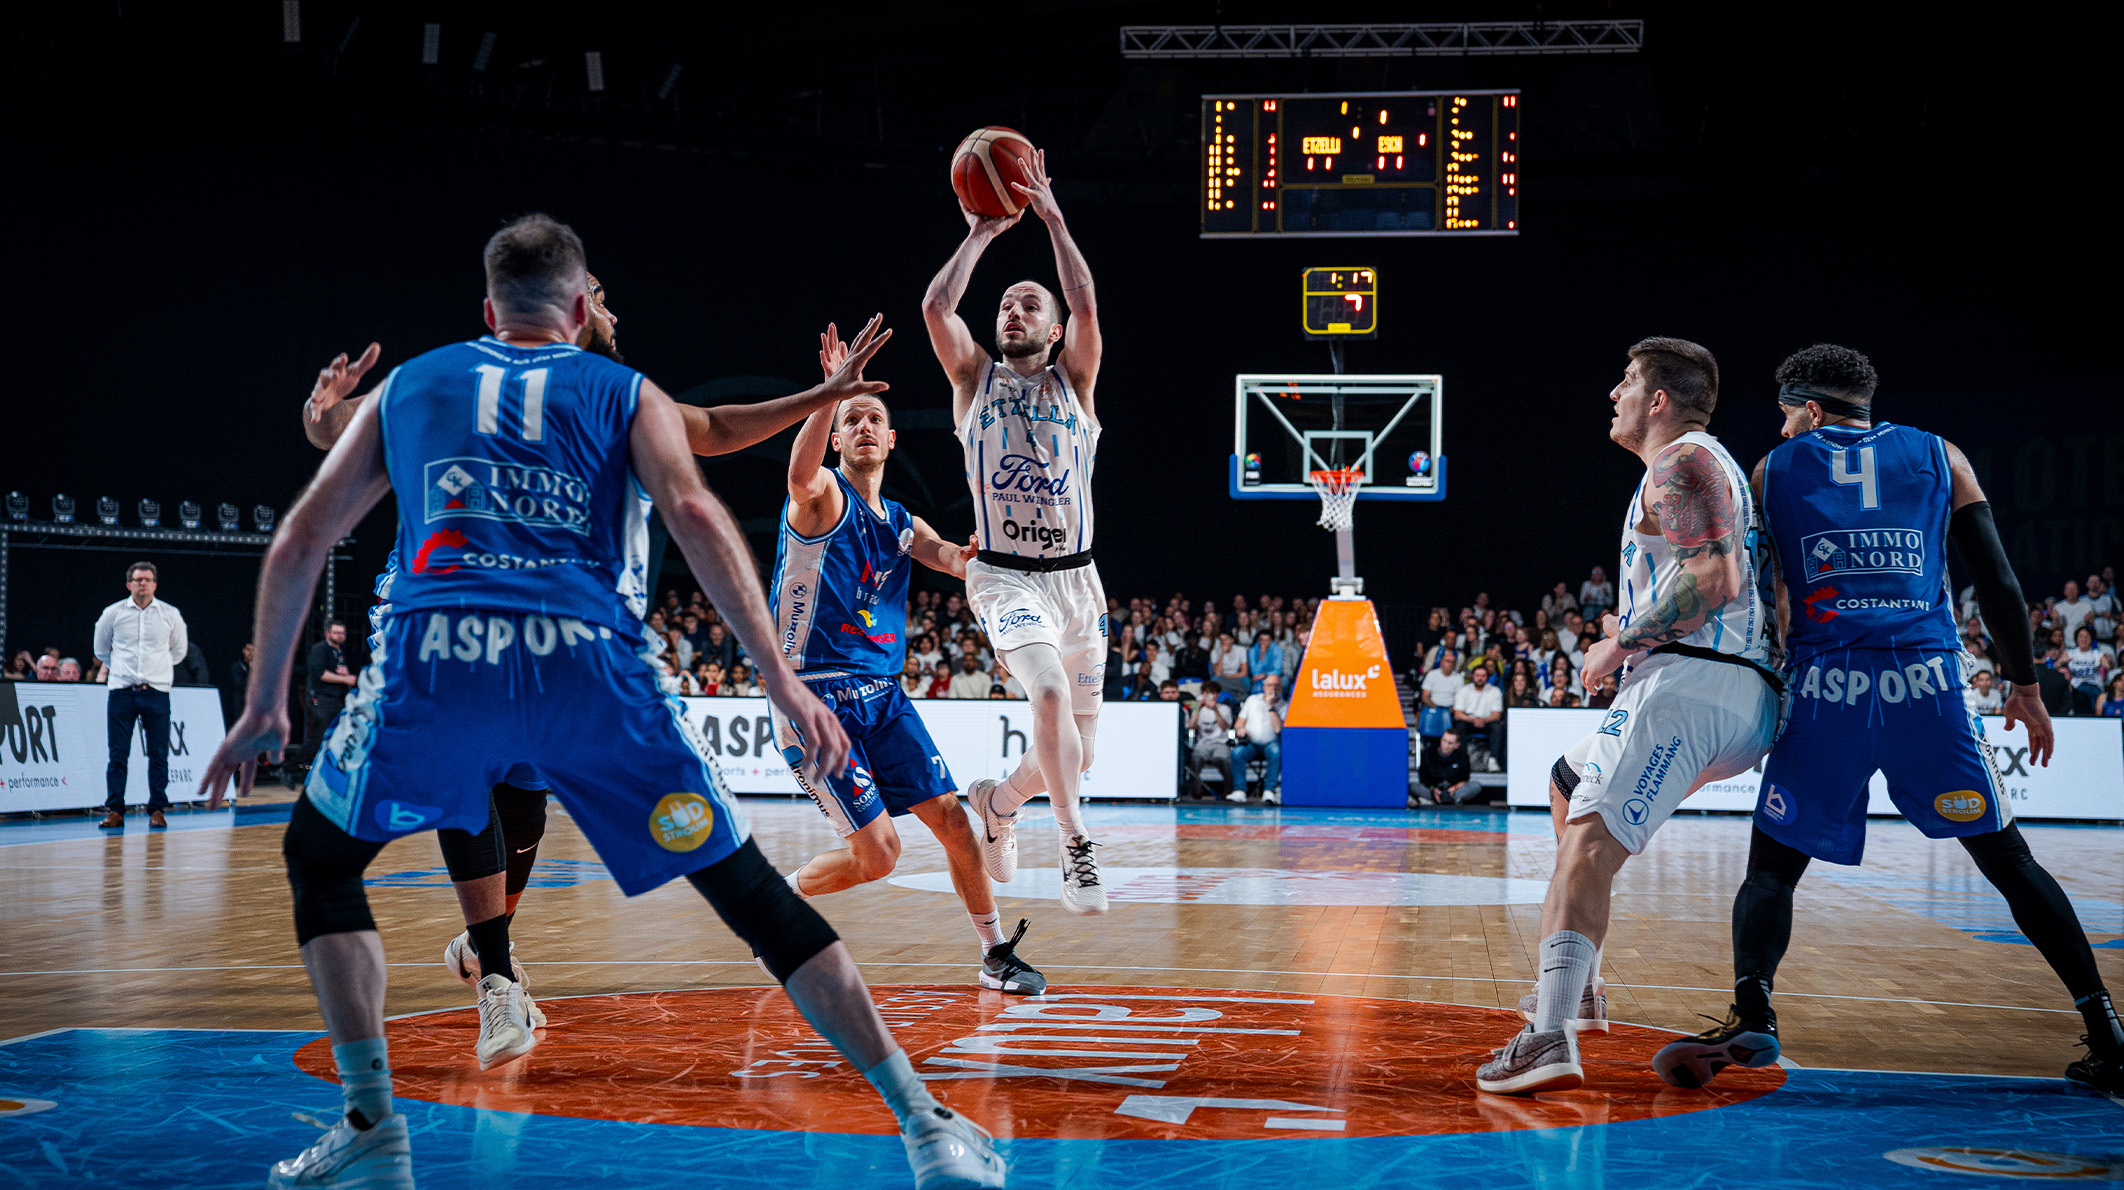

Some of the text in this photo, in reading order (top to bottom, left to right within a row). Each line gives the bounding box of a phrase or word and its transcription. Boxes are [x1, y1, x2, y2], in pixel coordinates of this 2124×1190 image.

[471, 363, 551, 443] 11
[979, 397, 1077, 436] ETZELLA
[490, 465, 585, 503] IMMO
[991, 453, 1070, 497] Ford
[1830, 444, 1881, 511] 4
[490, 489, 588, 526] NORD
[992, 492, 1020, 503] PAUL
[1848, 532, 1921, 549] IMMO
[1850, 551, 1922, 568] NORD
[998, 607, 1043, 633] Ford
[1836, 598, 1930, 612] COSTANTINI
[418, 612, 613, 665] ASPOR
[1311, 668, 1368, 690] lalux
[1801, 655, 1949, 706] ASPORT
[702, 714, 774, 758] ASP
[8, 771, 60, 793] performance
[930, 755, 947, 780] 7
[1633, 743, 1665, 796] VOYAGES
[1646, 735, 1683, 803] FLAMMANG
[1699, 783, 1757, 794] ormance
